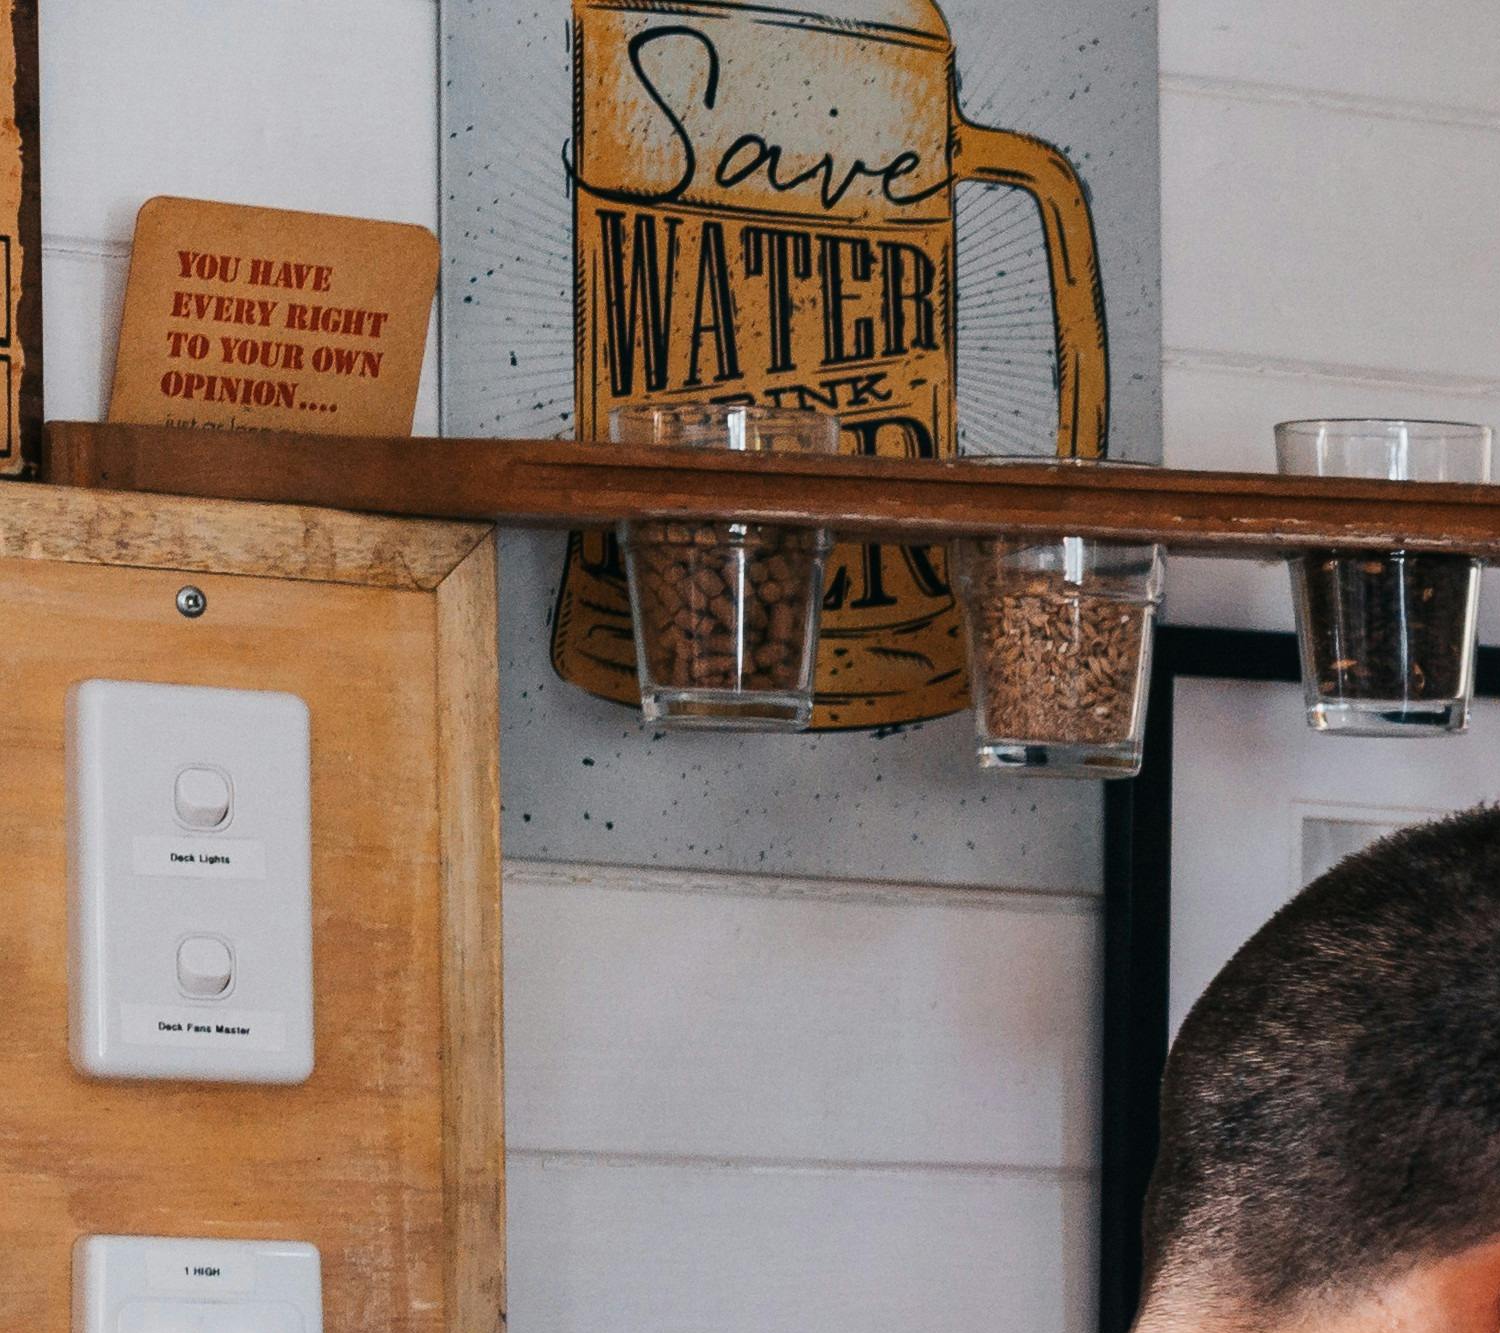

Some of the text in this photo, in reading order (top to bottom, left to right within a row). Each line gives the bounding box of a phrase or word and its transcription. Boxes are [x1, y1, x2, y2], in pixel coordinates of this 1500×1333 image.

[562, 25, 957, 209] Save
[177, 251, 333, 292] YOU HAVE
[170, 291, 388, 338] EVERY RIGHT
[596, 209, 940, 397] WATER
[167, 331, 384, 378] TO YOUR OWN
[160, 370, 338, 413] OPINION....
[170, 852, 230, 865] Deck Lights
[158, 1021, 250, 1035] Deck Fans Master
[193, 1267, 220, 1277] HIGH
